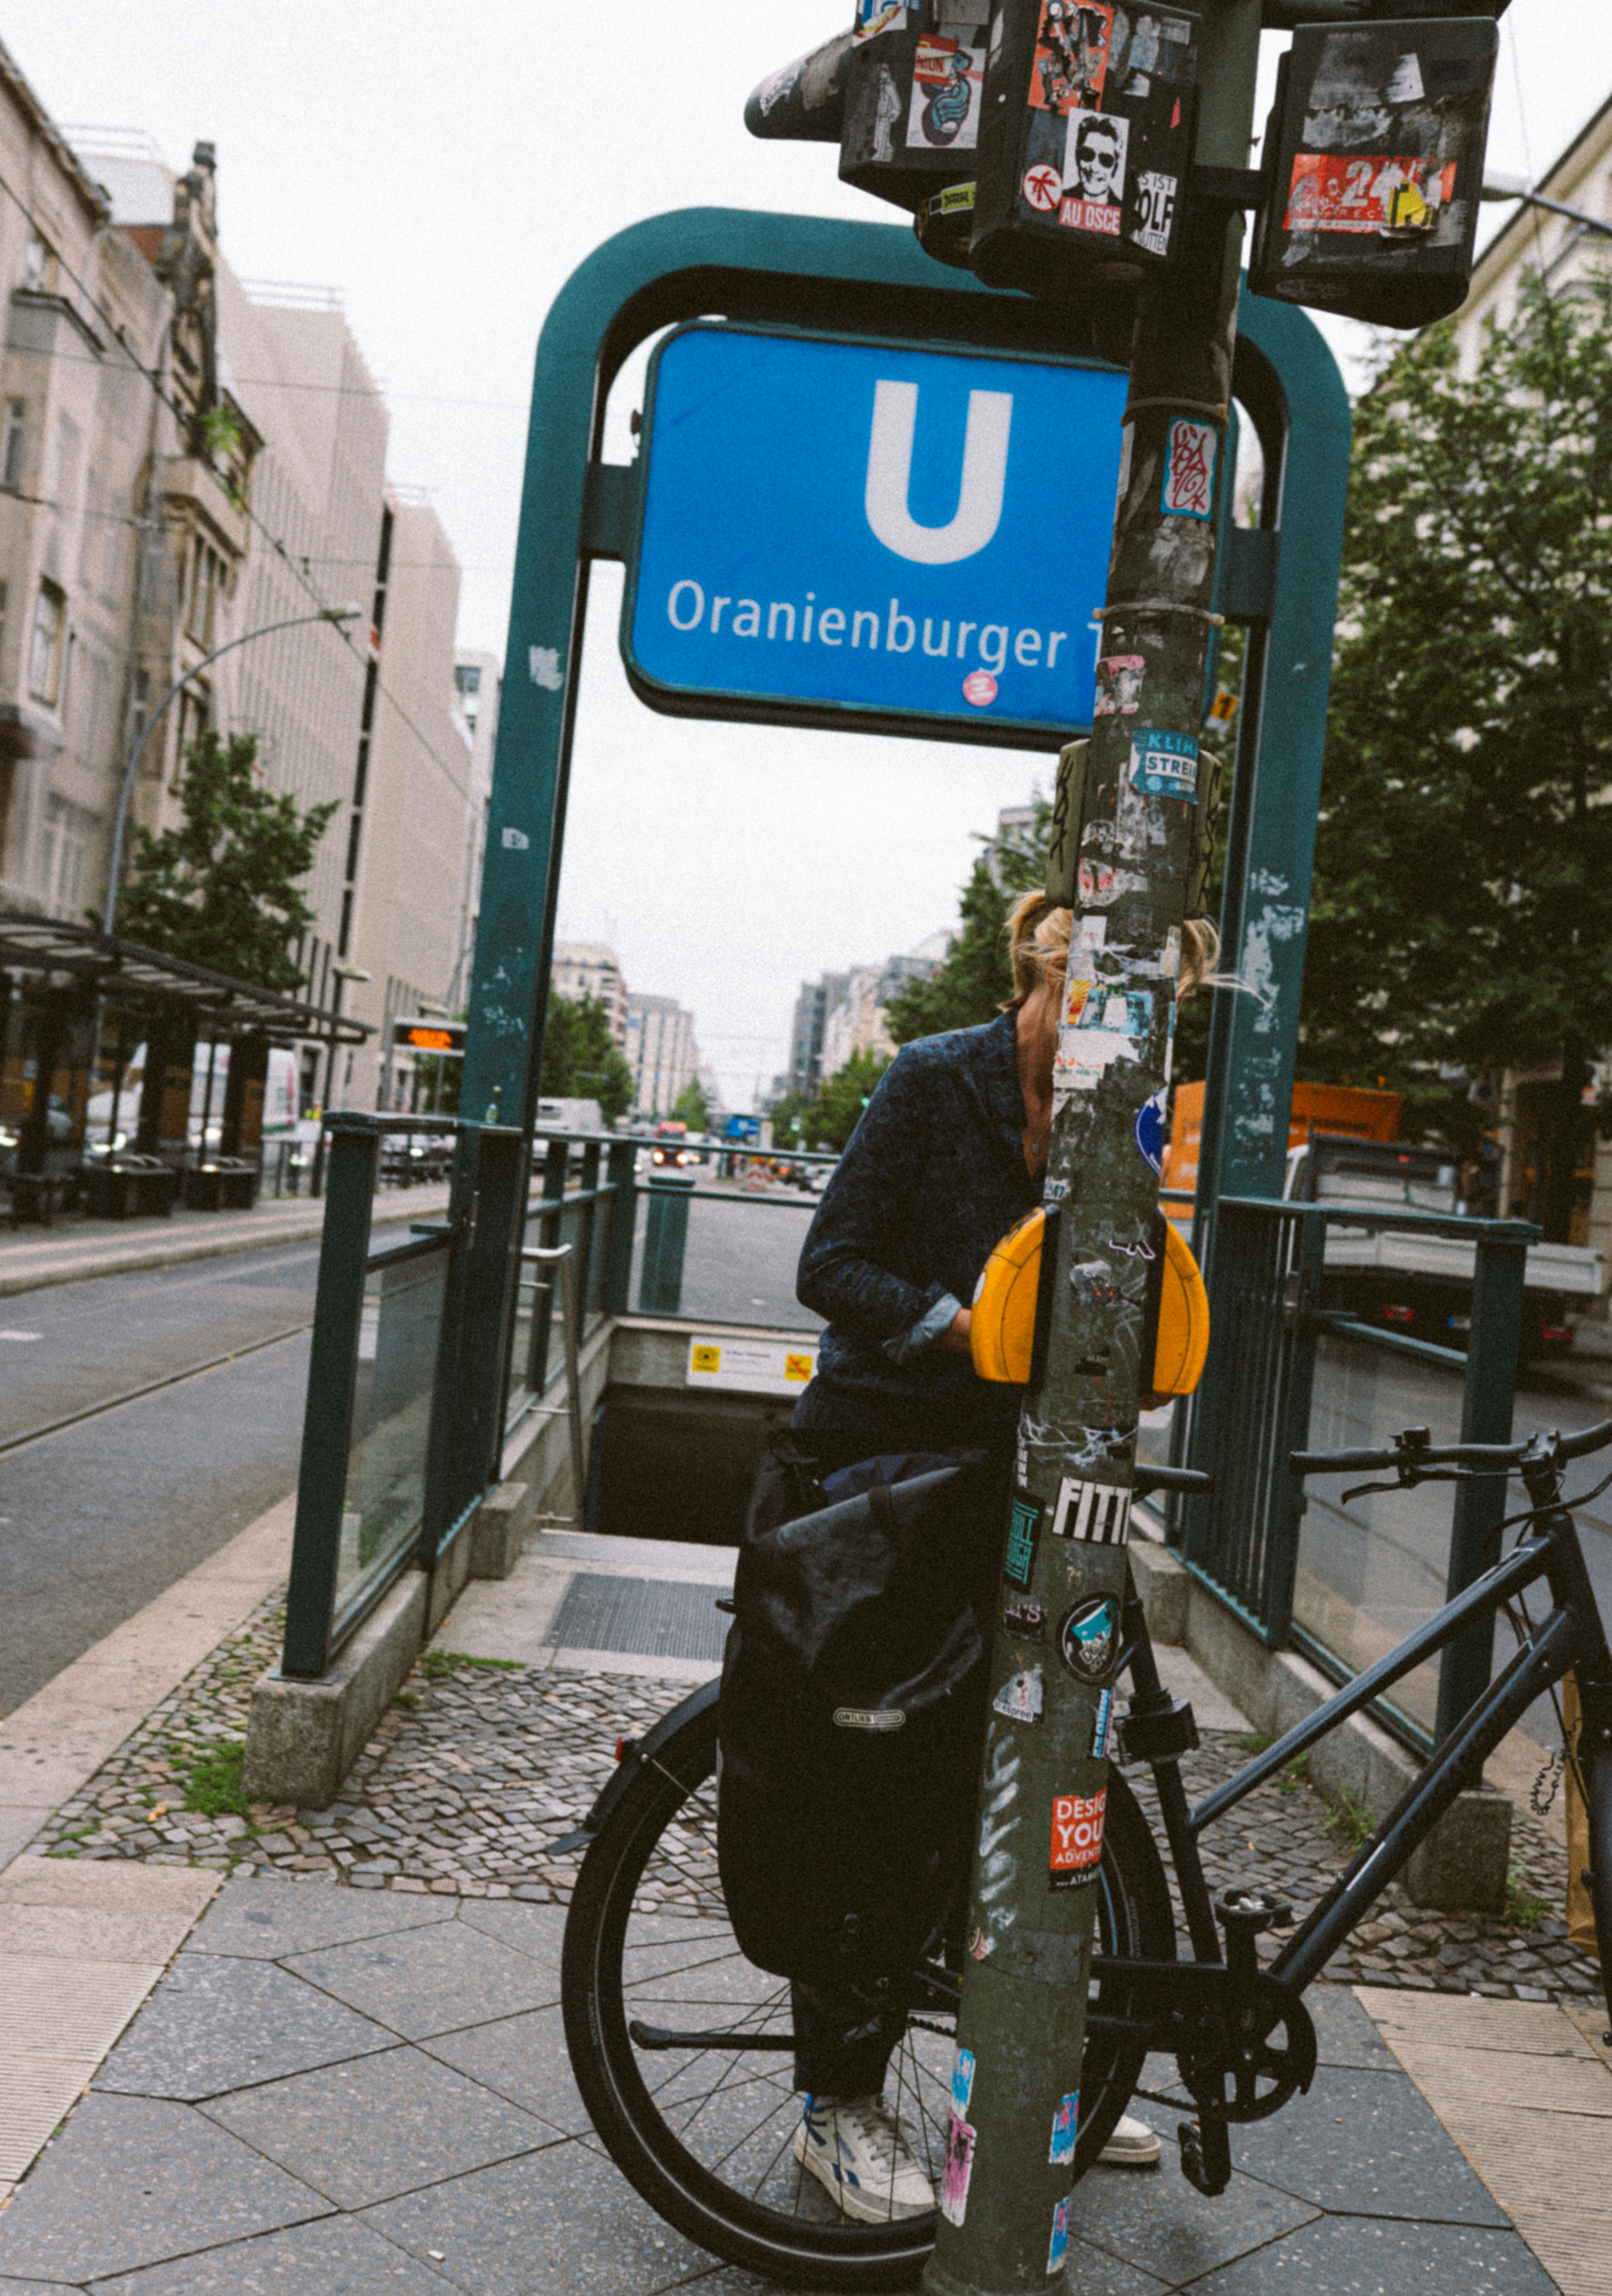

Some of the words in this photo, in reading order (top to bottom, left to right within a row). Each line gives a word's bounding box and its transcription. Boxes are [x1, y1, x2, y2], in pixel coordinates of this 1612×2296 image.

[1153, 176, 1175, 191] IST
[1062, 200, 1082, 225] AU
[1084, 205, 1120, 232] OSCE
[864, 378, 1013, 565] U
[667, 579, 1067, 676] Oranienburger
